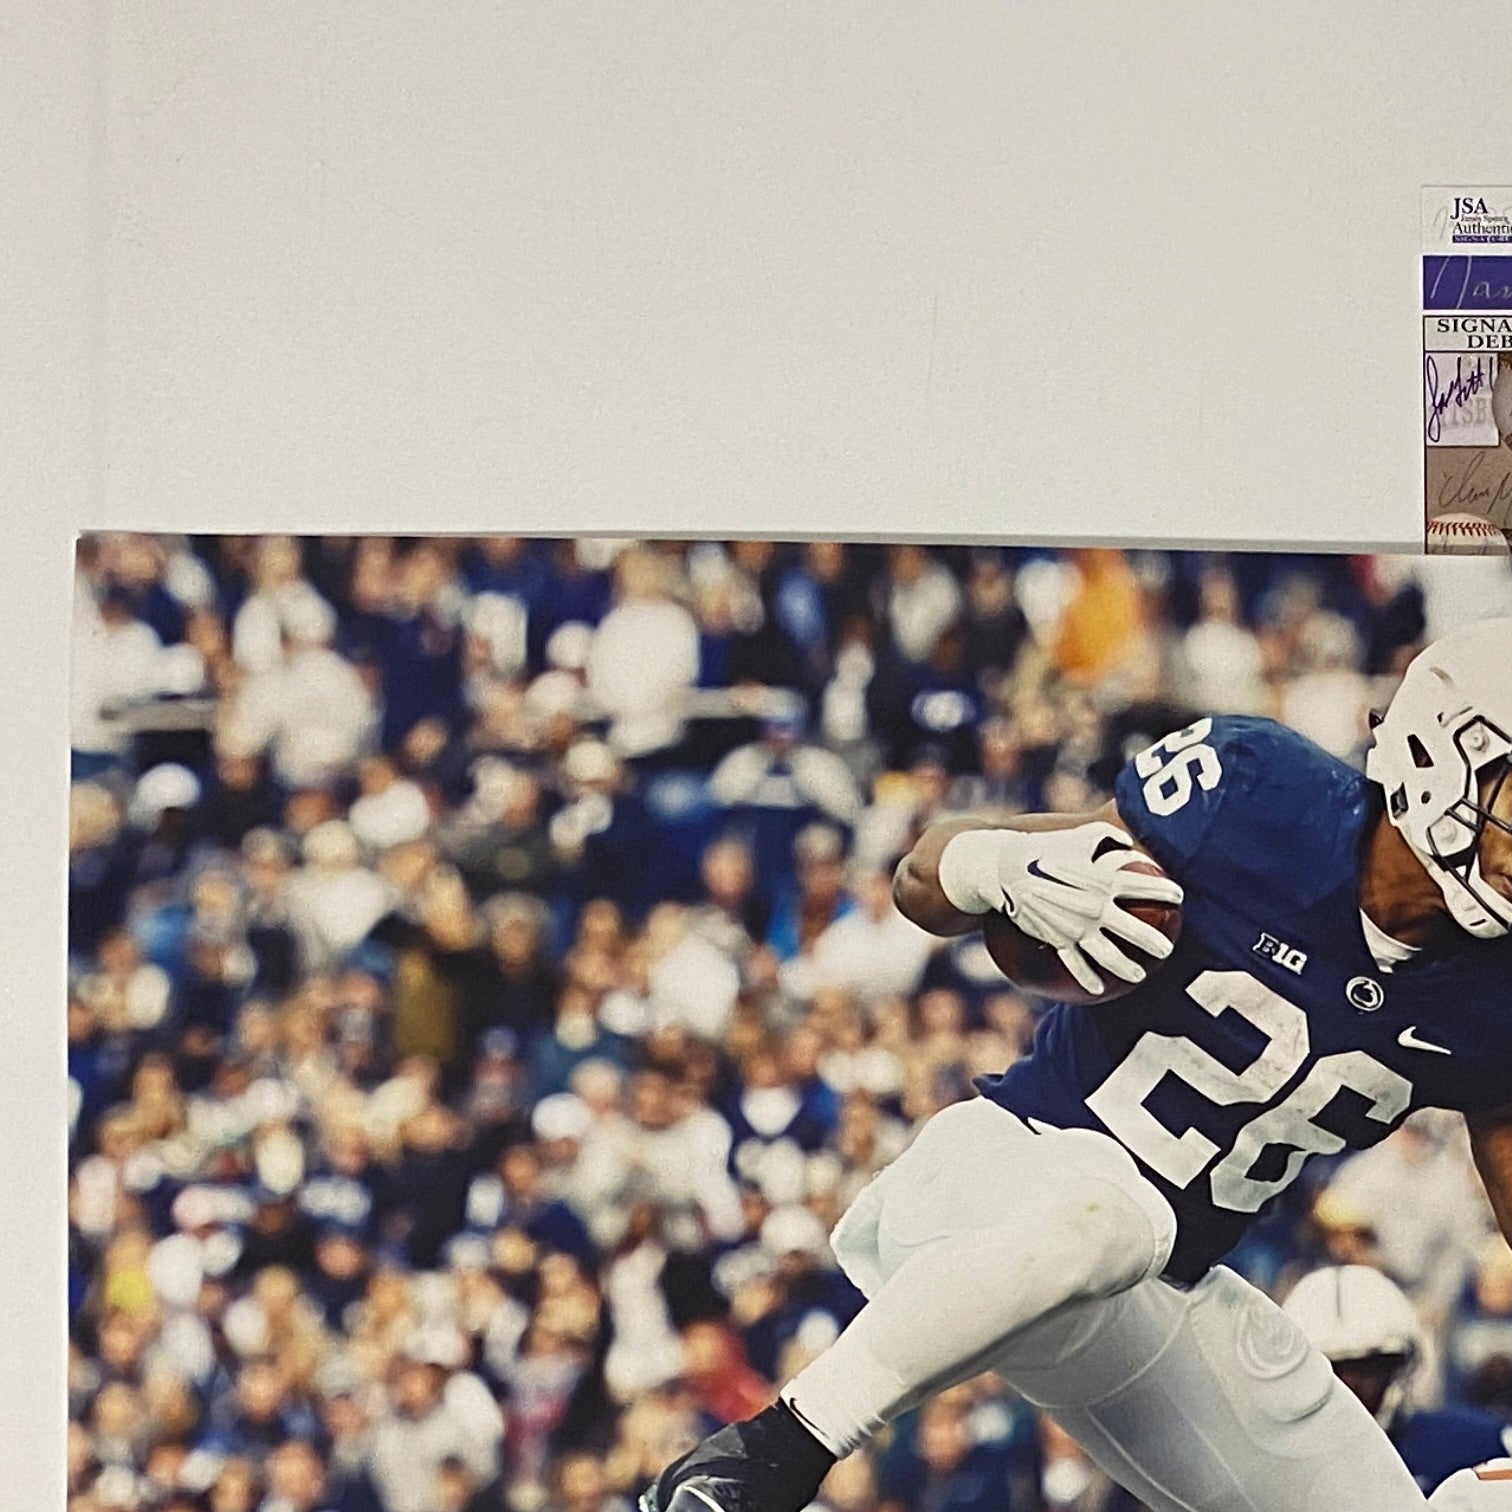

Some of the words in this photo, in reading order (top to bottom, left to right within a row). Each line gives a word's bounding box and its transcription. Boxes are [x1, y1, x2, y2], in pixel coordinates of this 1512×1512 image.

[1450, 197, 1489, 220] JSA
[1135, 717, 1223, 817] 26
[1085, 970, 1413, 1213] 26
